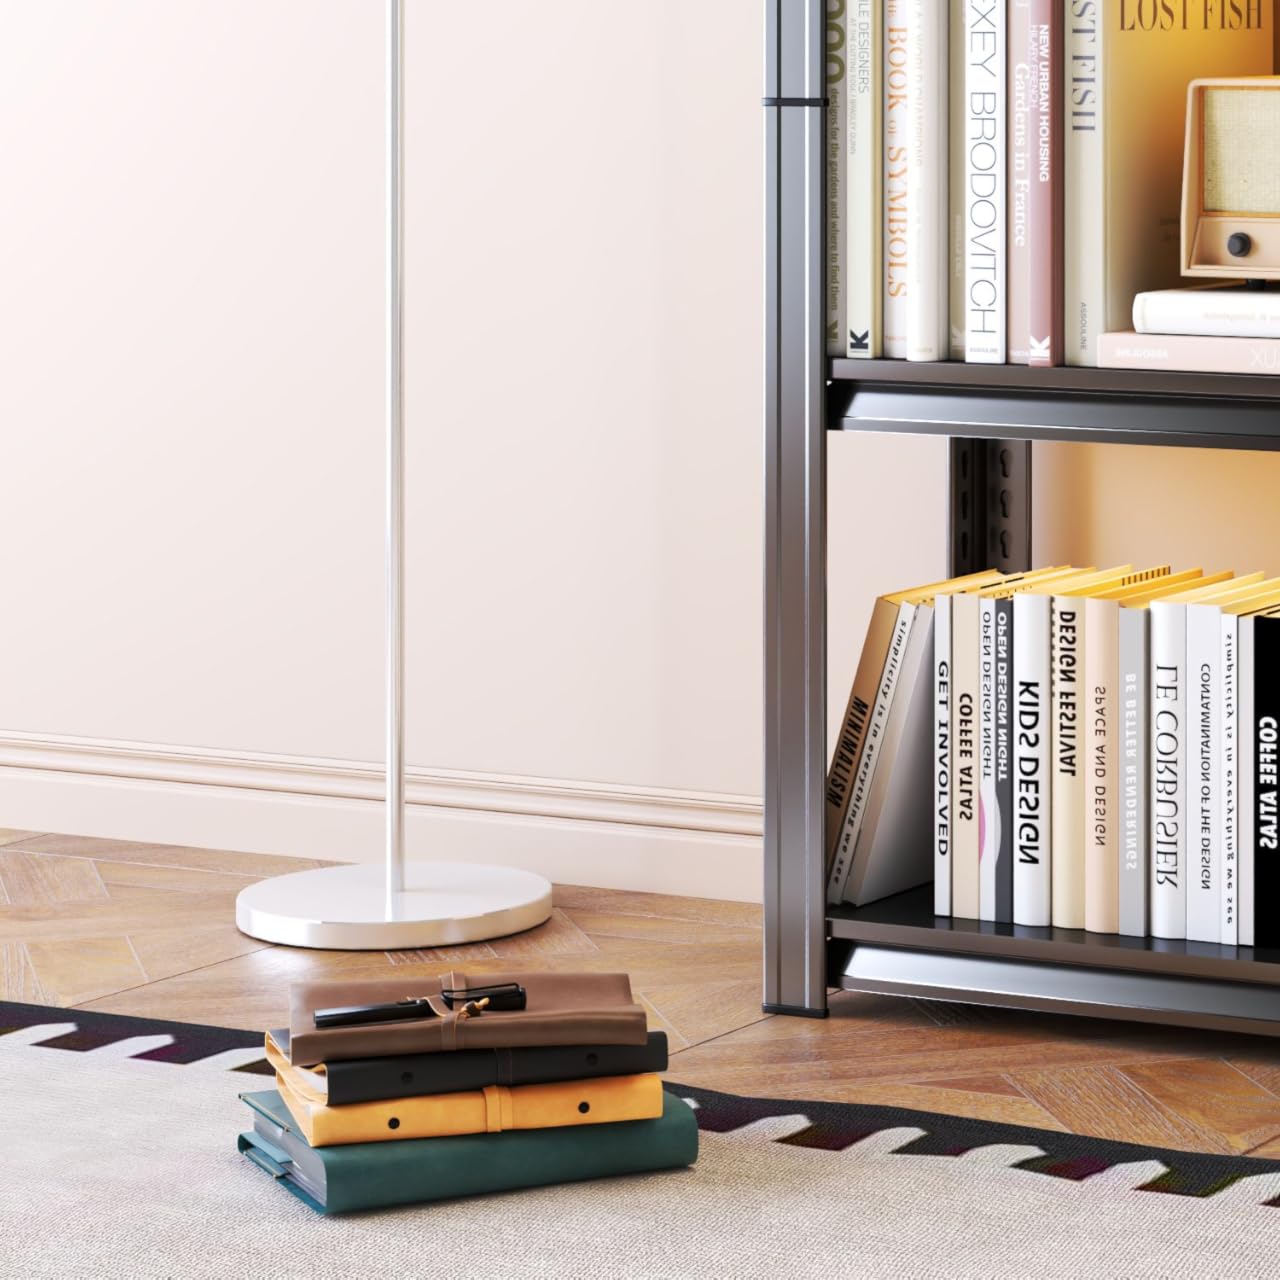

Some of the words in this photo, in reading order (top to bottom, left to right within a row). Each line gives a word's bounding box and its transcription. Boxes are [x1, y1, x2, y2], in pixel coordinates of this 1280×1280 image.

[857, 22, 871, 94] DESIGNERS
[1038, 24, 1050, 58] NEW
[887, 25, 908, 113] BOOK
[1038, 61, 1050, 113] URBAN
[828, 88, 839, 125] designs
[1013, 62, 1031, 146] Gardens
[1071, 53, 1095, 132] FISH
[828, 127, 839, 142] for
[828, 143, 839, 159] the
[1038, 115, 1050, 183] HOUSING
[828, 161, 839, 198] gardens
[1013, 151, 1031, 170] in
[828, 201, 839, 219] and
[887, 146, 908, 298] SYMBOLS
[970, 92, 997, 334] BRODOVITCH
[1013, 180, 1031, 248] France
[828, 221, 839, 251] where
[828, 253, 839, 262] to
[828, 265, 839, 284] find
[828, 286, 839, 311] them
[1079, 301, 1088, 351] ASSOULINE
[880, 619, 908, 699] simplicity
[937, 660, 949, 711] GET
[870, 722, 882, 739] in
[875, 703, 888, 718] is
[826, 695, 869, 809] MINIMALISM
[845, 743, 876, 828] everything
[938, 720, 949, 856] INVOLVED
[841, 832, 851, 854] we
[832, 856, 845, 886] see
